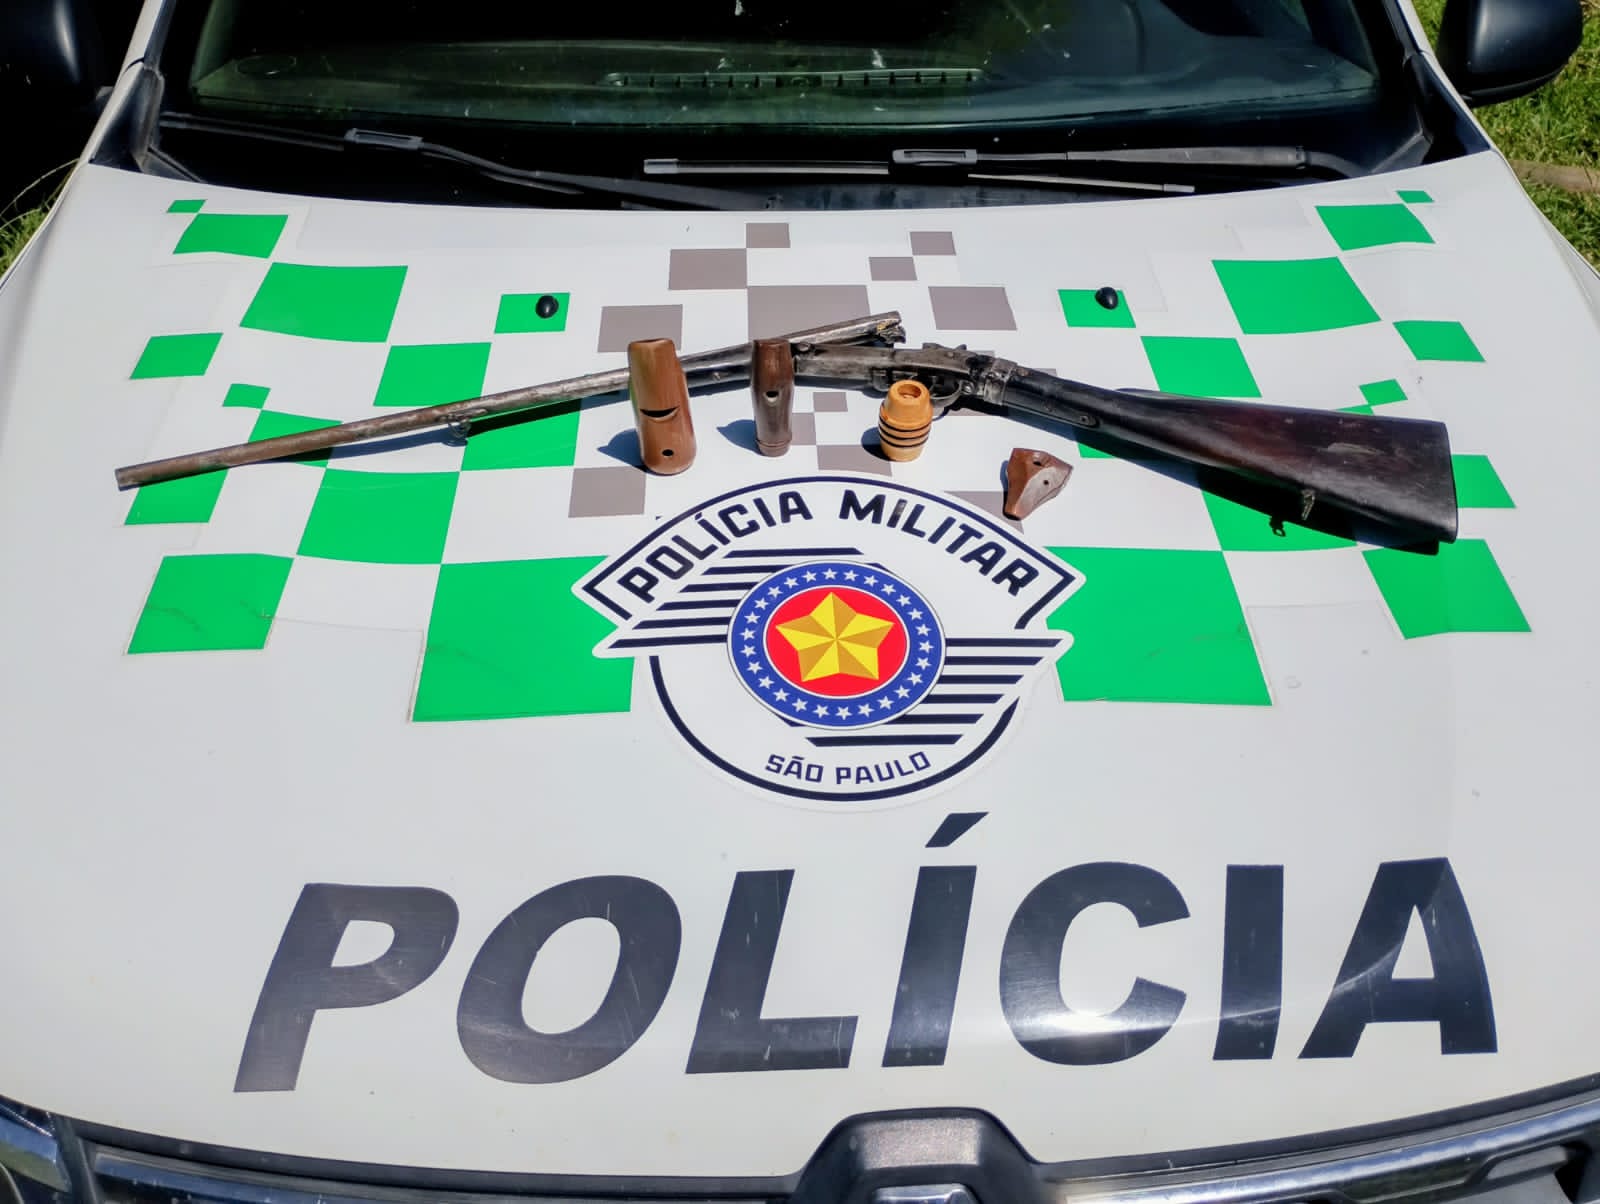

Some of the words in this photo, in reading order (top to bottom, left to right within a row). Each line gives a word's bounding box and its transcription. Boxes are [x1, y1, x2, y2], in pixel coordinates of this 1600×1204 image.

[617, 490, 812, 603] POLÍCIA
[839, 489, 1039, 596] MILITAR
[765, 754, 823, 783] SÃO
[836, 751, 931, 785] PAULO
[234, 811, 1498, 1093] POLÍCIA
